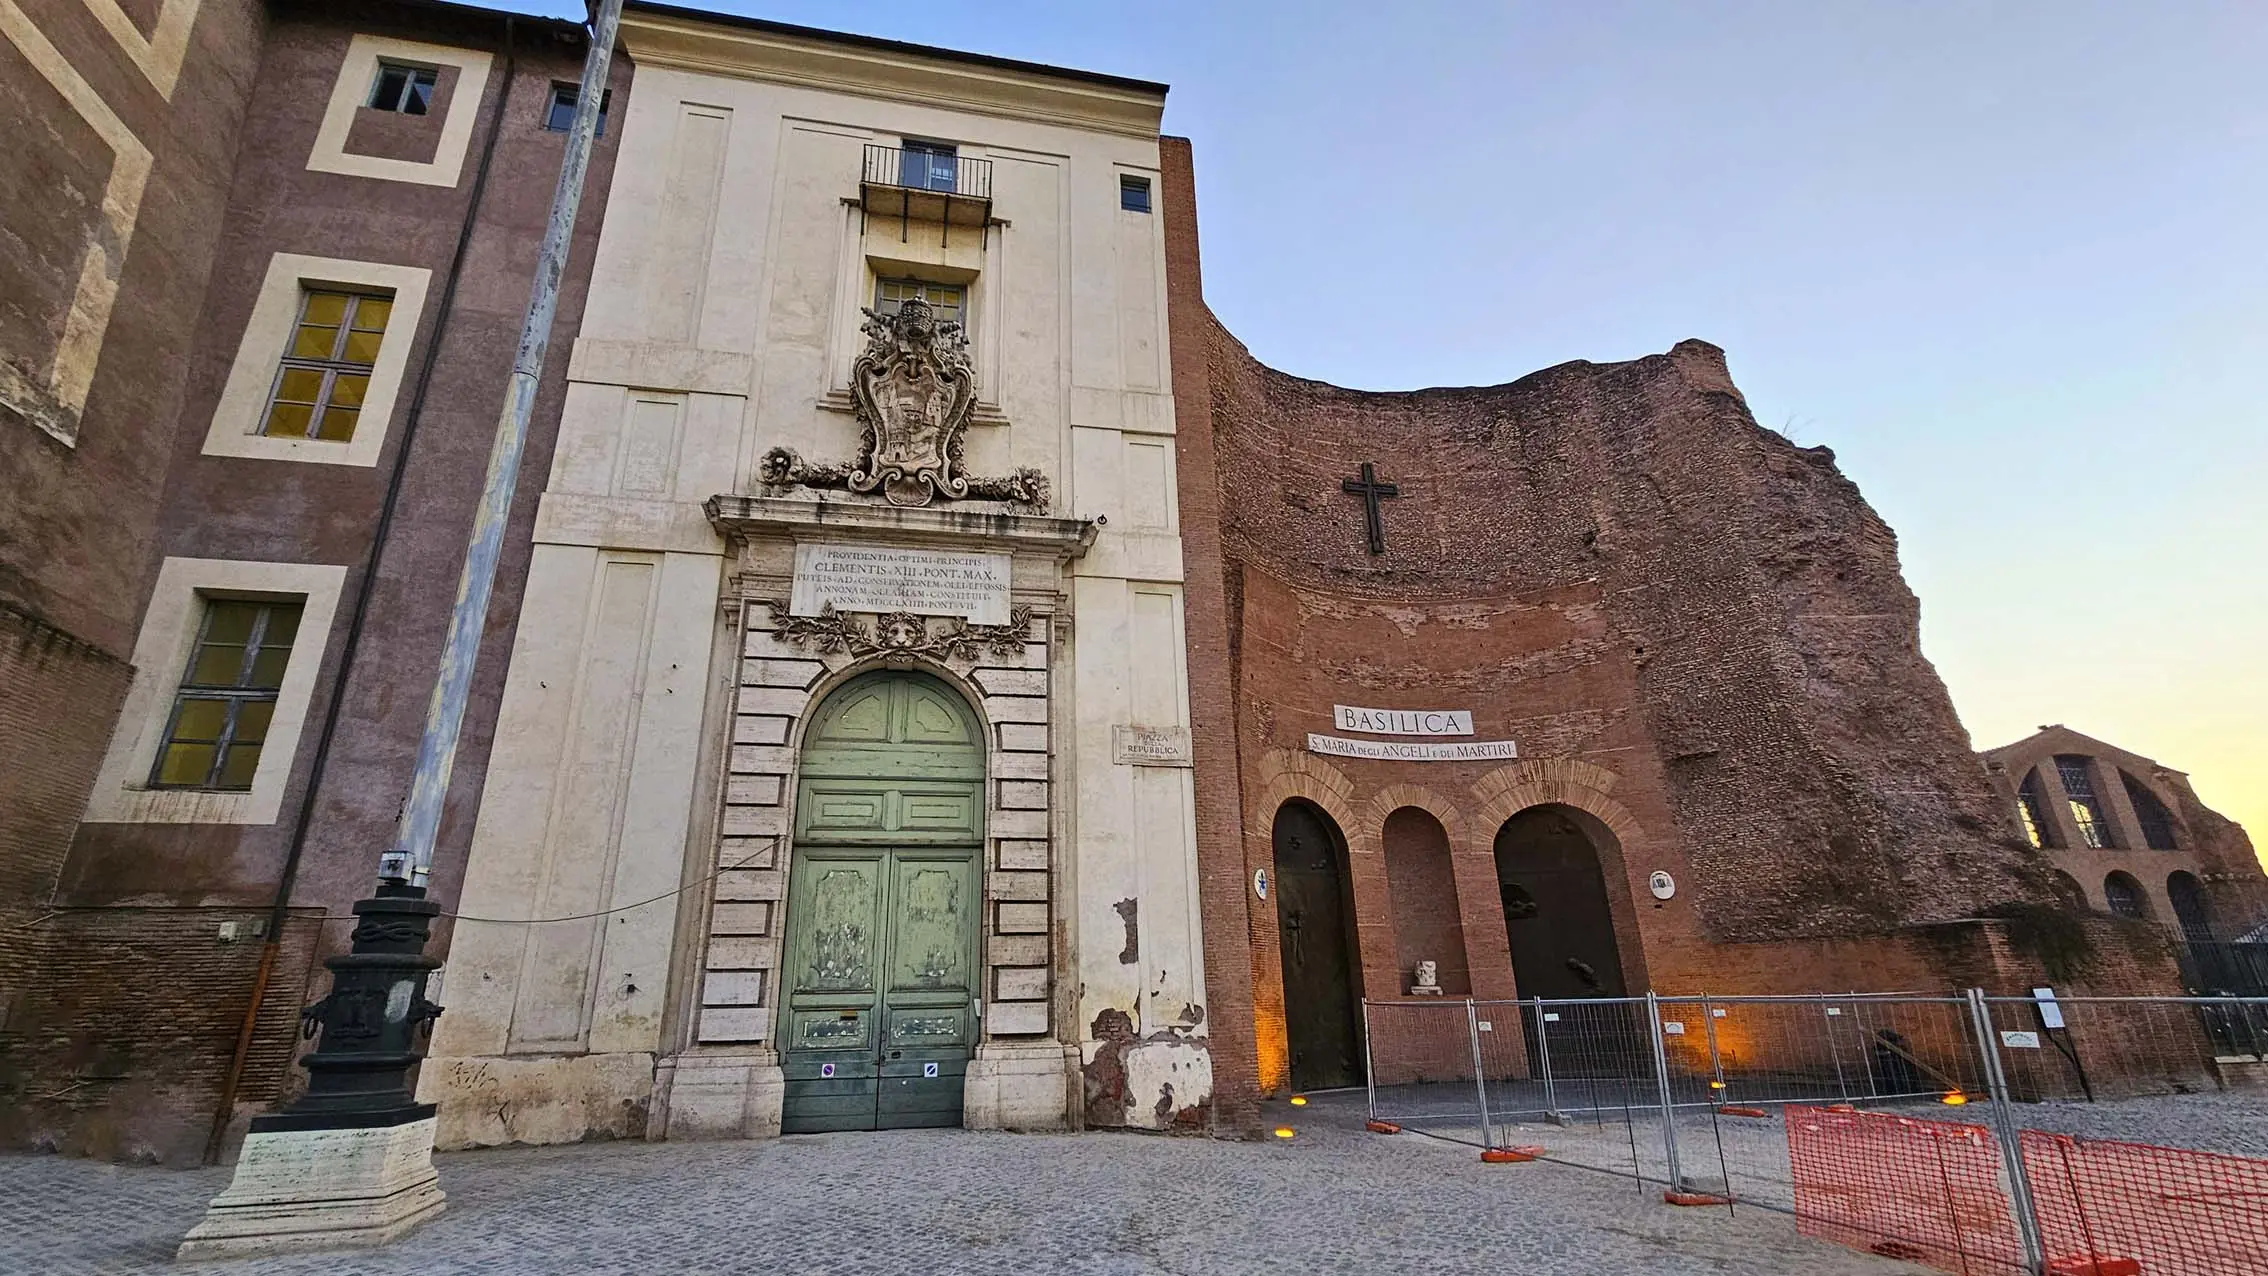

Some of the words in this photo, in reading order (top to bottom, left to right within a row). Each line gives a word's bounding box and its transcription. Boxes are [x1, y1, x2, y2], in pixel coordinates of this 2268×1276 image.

[814, 562, 887, 575] CLEMENTIS
[836, 576, 853, 584] AD
[1344, 708, 1460, 733] BASILICA
[1137, 732, 1169, 742] PIAZZA
[1127, 745, 1179, 754] REPUBBLICA
[1311, 736, 1320, 749] S.
[1322, 738, 1357, 754] MARIA
[1382, 744, 1430, 758] ANGELI
[1457, 743, 1512, 758] MARTIRI
